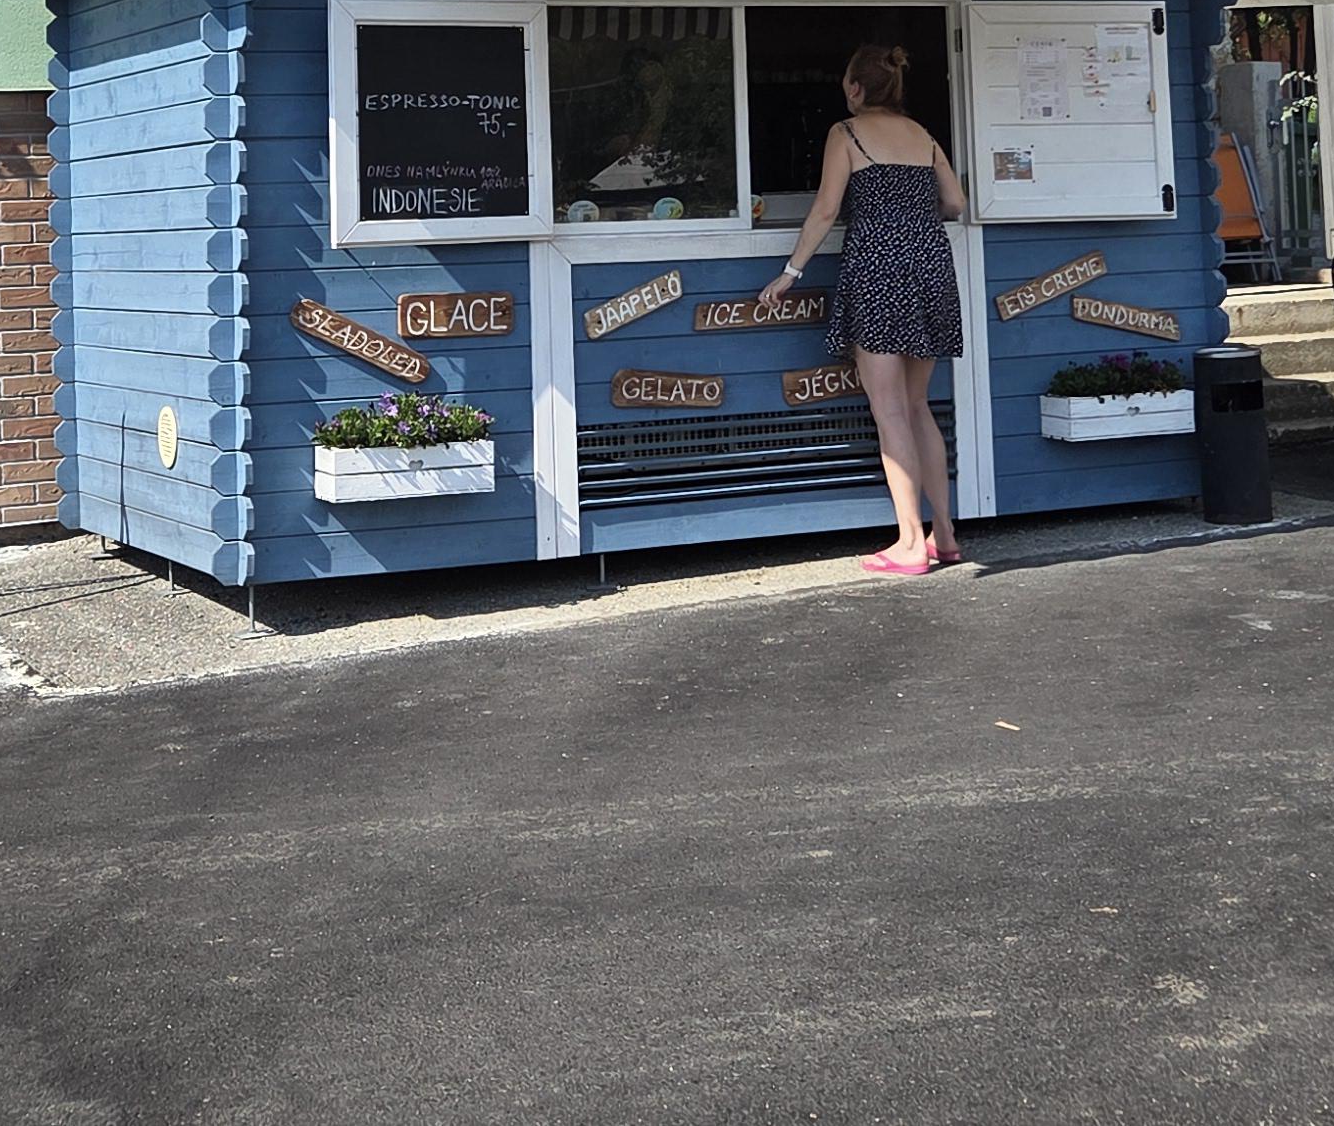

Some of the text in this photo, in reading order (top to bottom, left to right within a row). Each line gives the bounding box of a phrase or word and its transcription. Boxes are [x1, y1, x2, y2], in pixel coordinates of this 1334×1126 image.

[367, 165, 402, 179] DNES
[372, 187, 482, 215] INDONESIE
[407, 297, 508, 336] GLACE
[705, 296, 825, 326] ICE CREAM
[1077, 301, 1180, 334] DONDURMA
[299, 309, 424, 377] SLADOLED
[621, 377, 720, 401] GELATO
